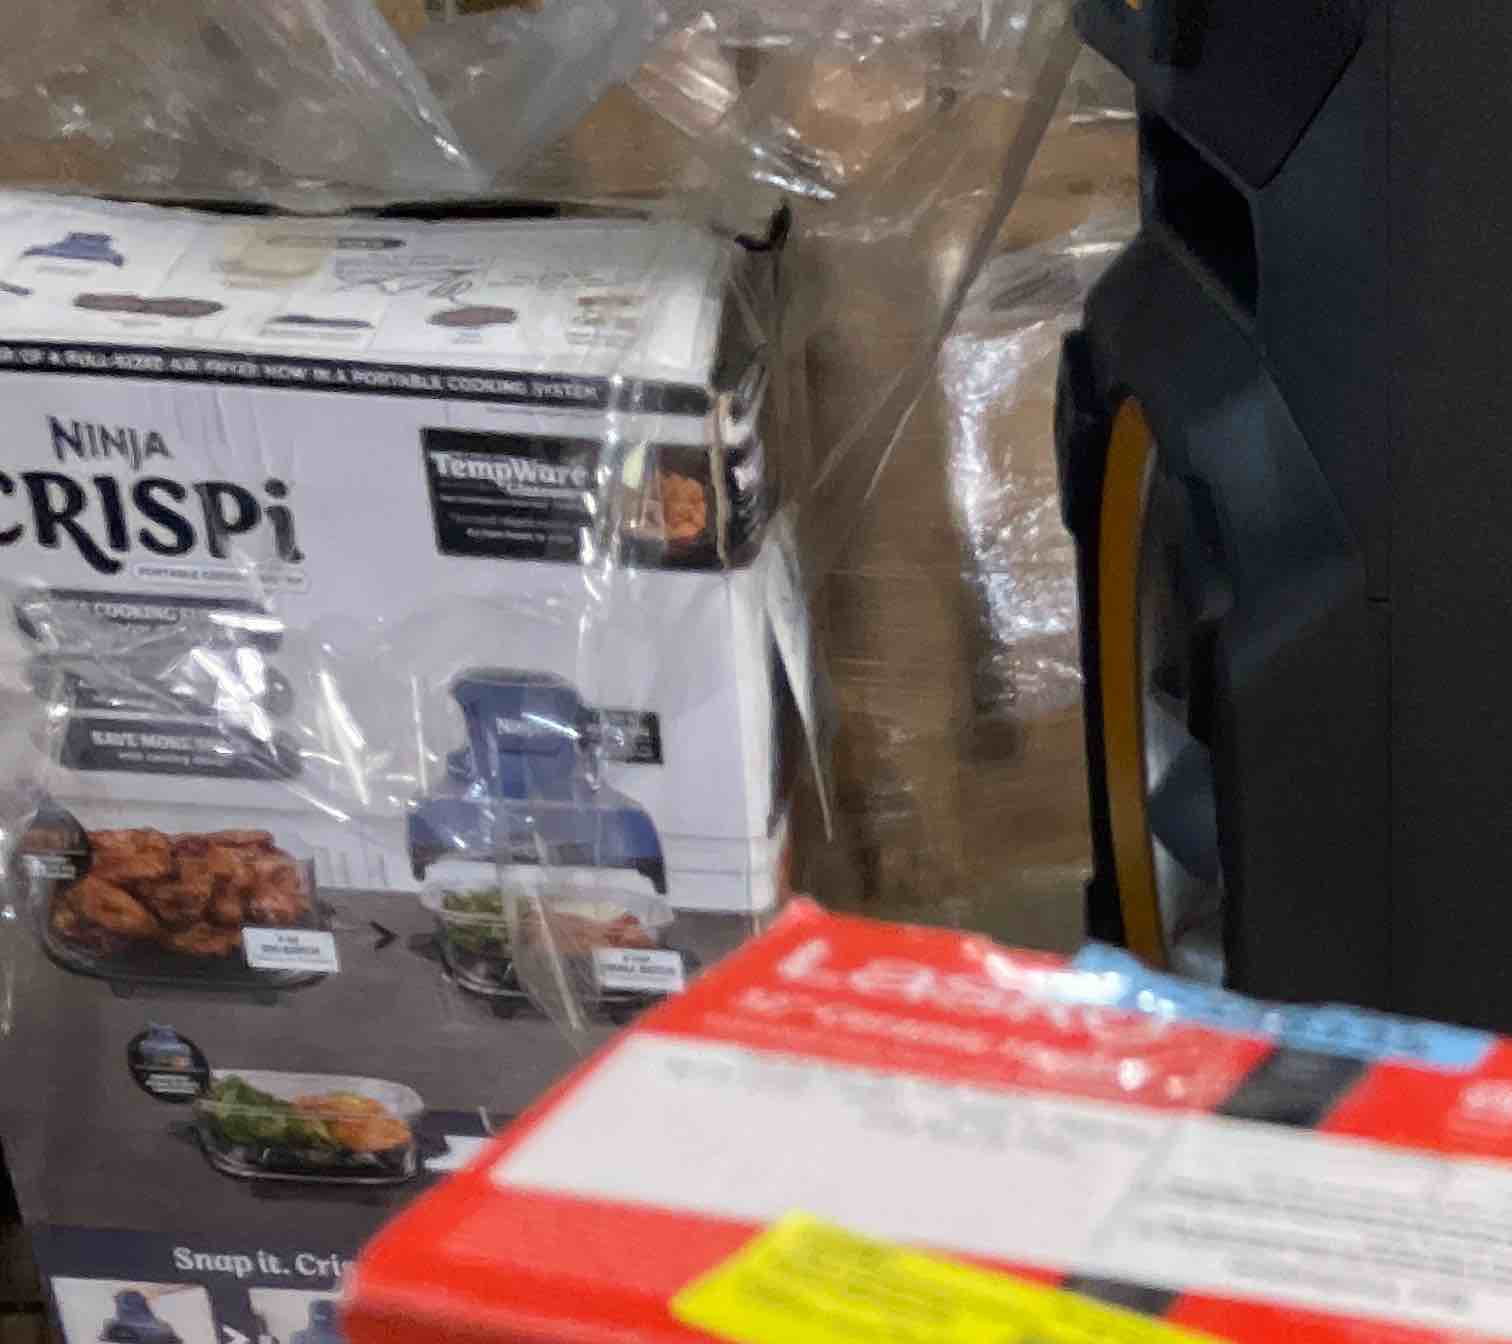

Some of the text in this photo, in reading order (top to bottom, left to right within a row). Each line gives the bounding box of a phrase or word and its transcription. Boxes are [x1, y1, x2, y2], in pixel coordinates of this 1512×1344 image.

[47, 414, 173, 470] NINJA
[173, 1246, 249, 1278] Snap
[255, 1249, 289, 1276] it.
